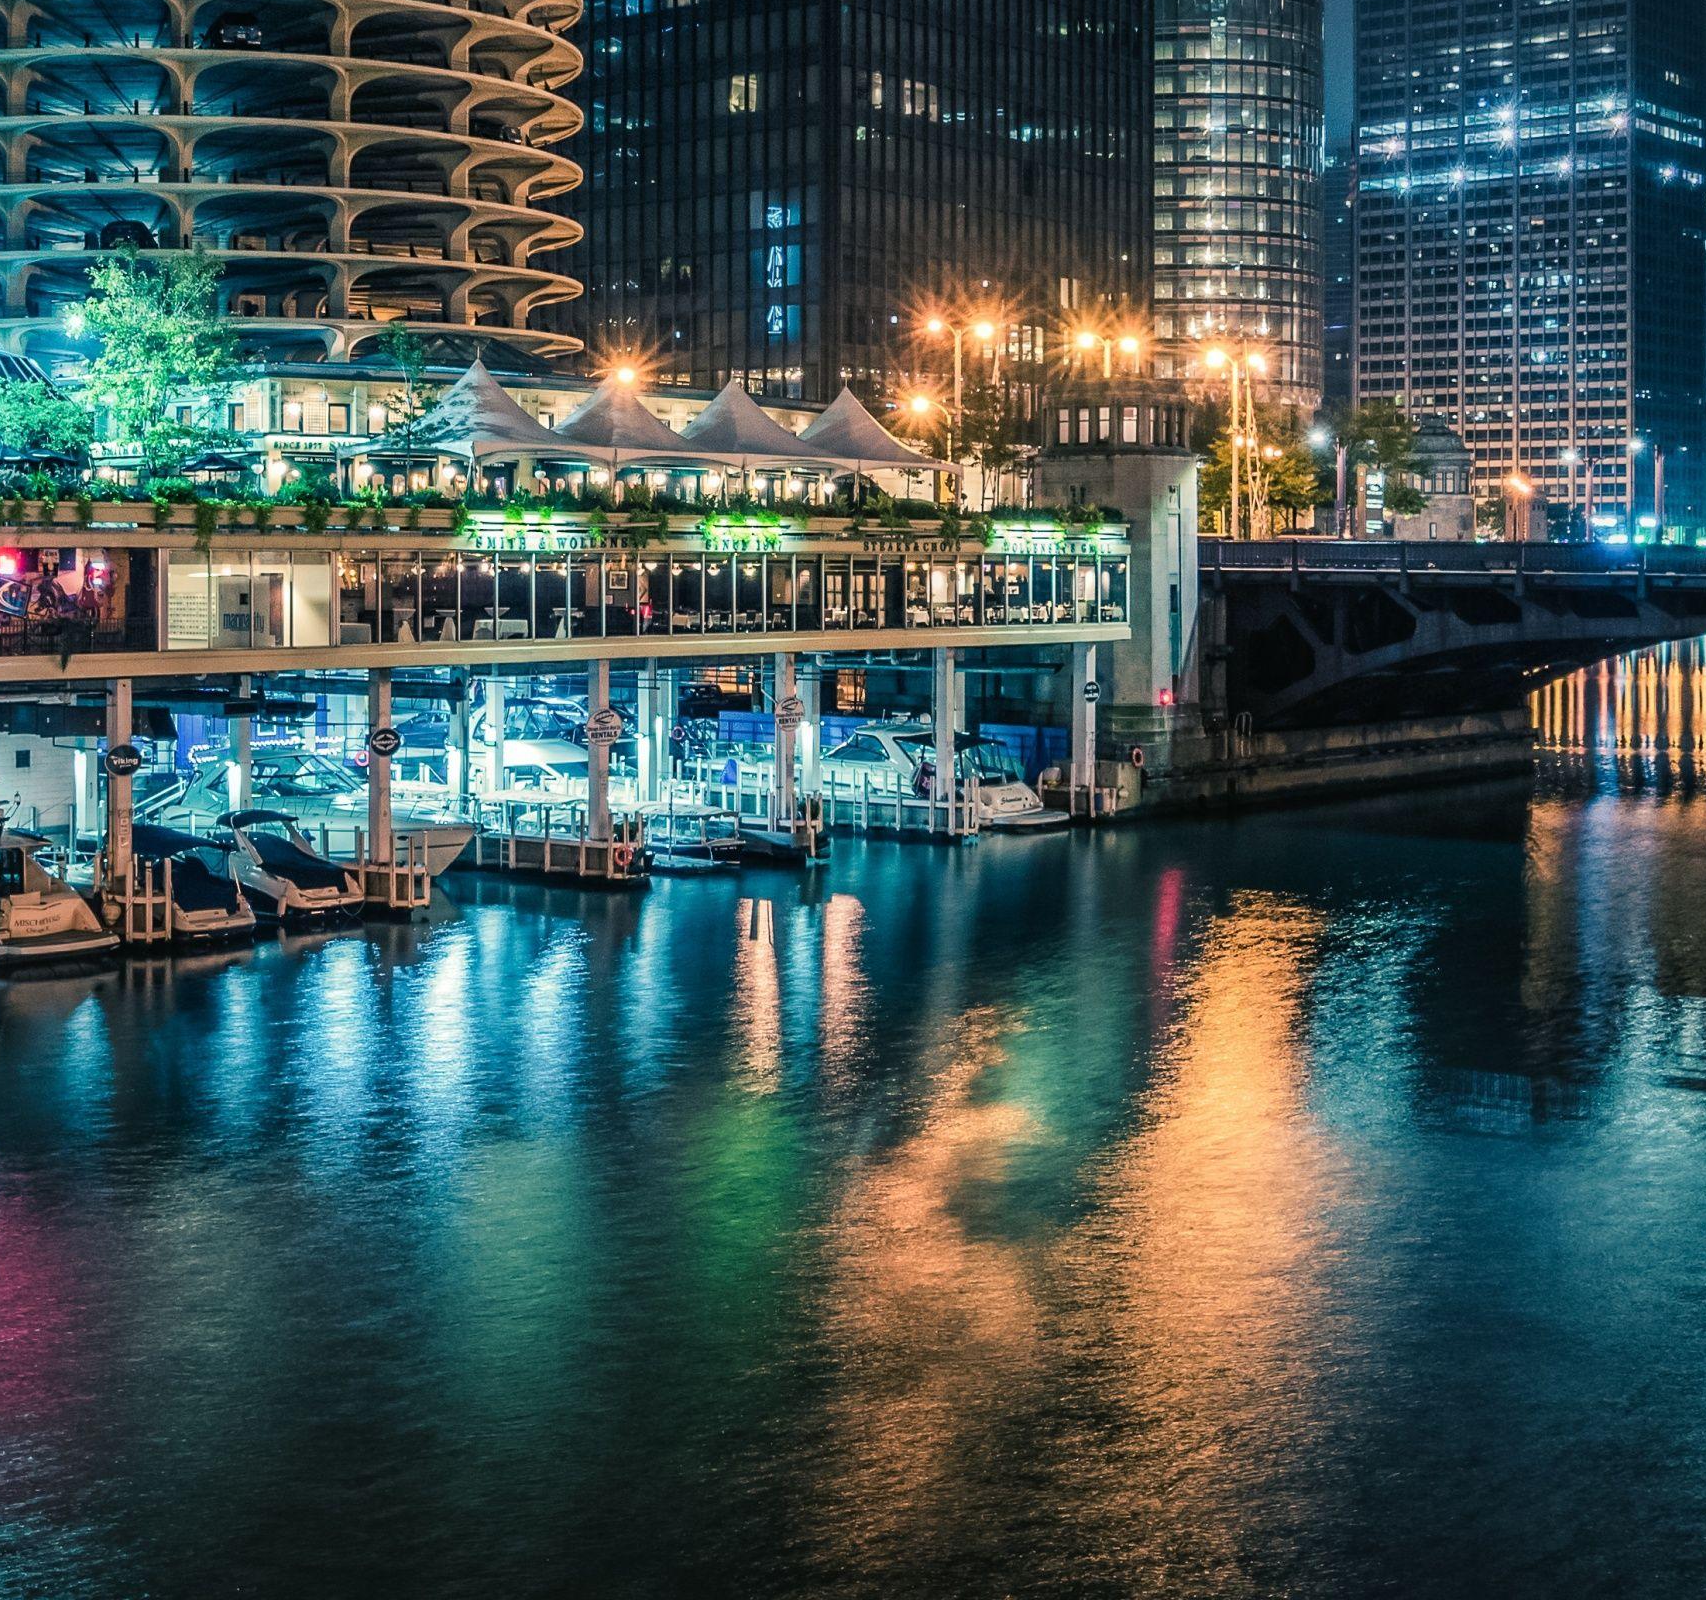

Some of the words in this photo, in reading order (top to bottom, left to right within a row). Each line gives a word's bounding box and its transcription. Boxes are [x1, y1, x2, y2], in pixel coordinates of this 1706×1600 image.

[273, 441, 301, 451] SINCE
[475, 535, 527, 550] SMITH
[590, 731, 618, 739] RENTALS
[110, 755, 139, 766] viking
